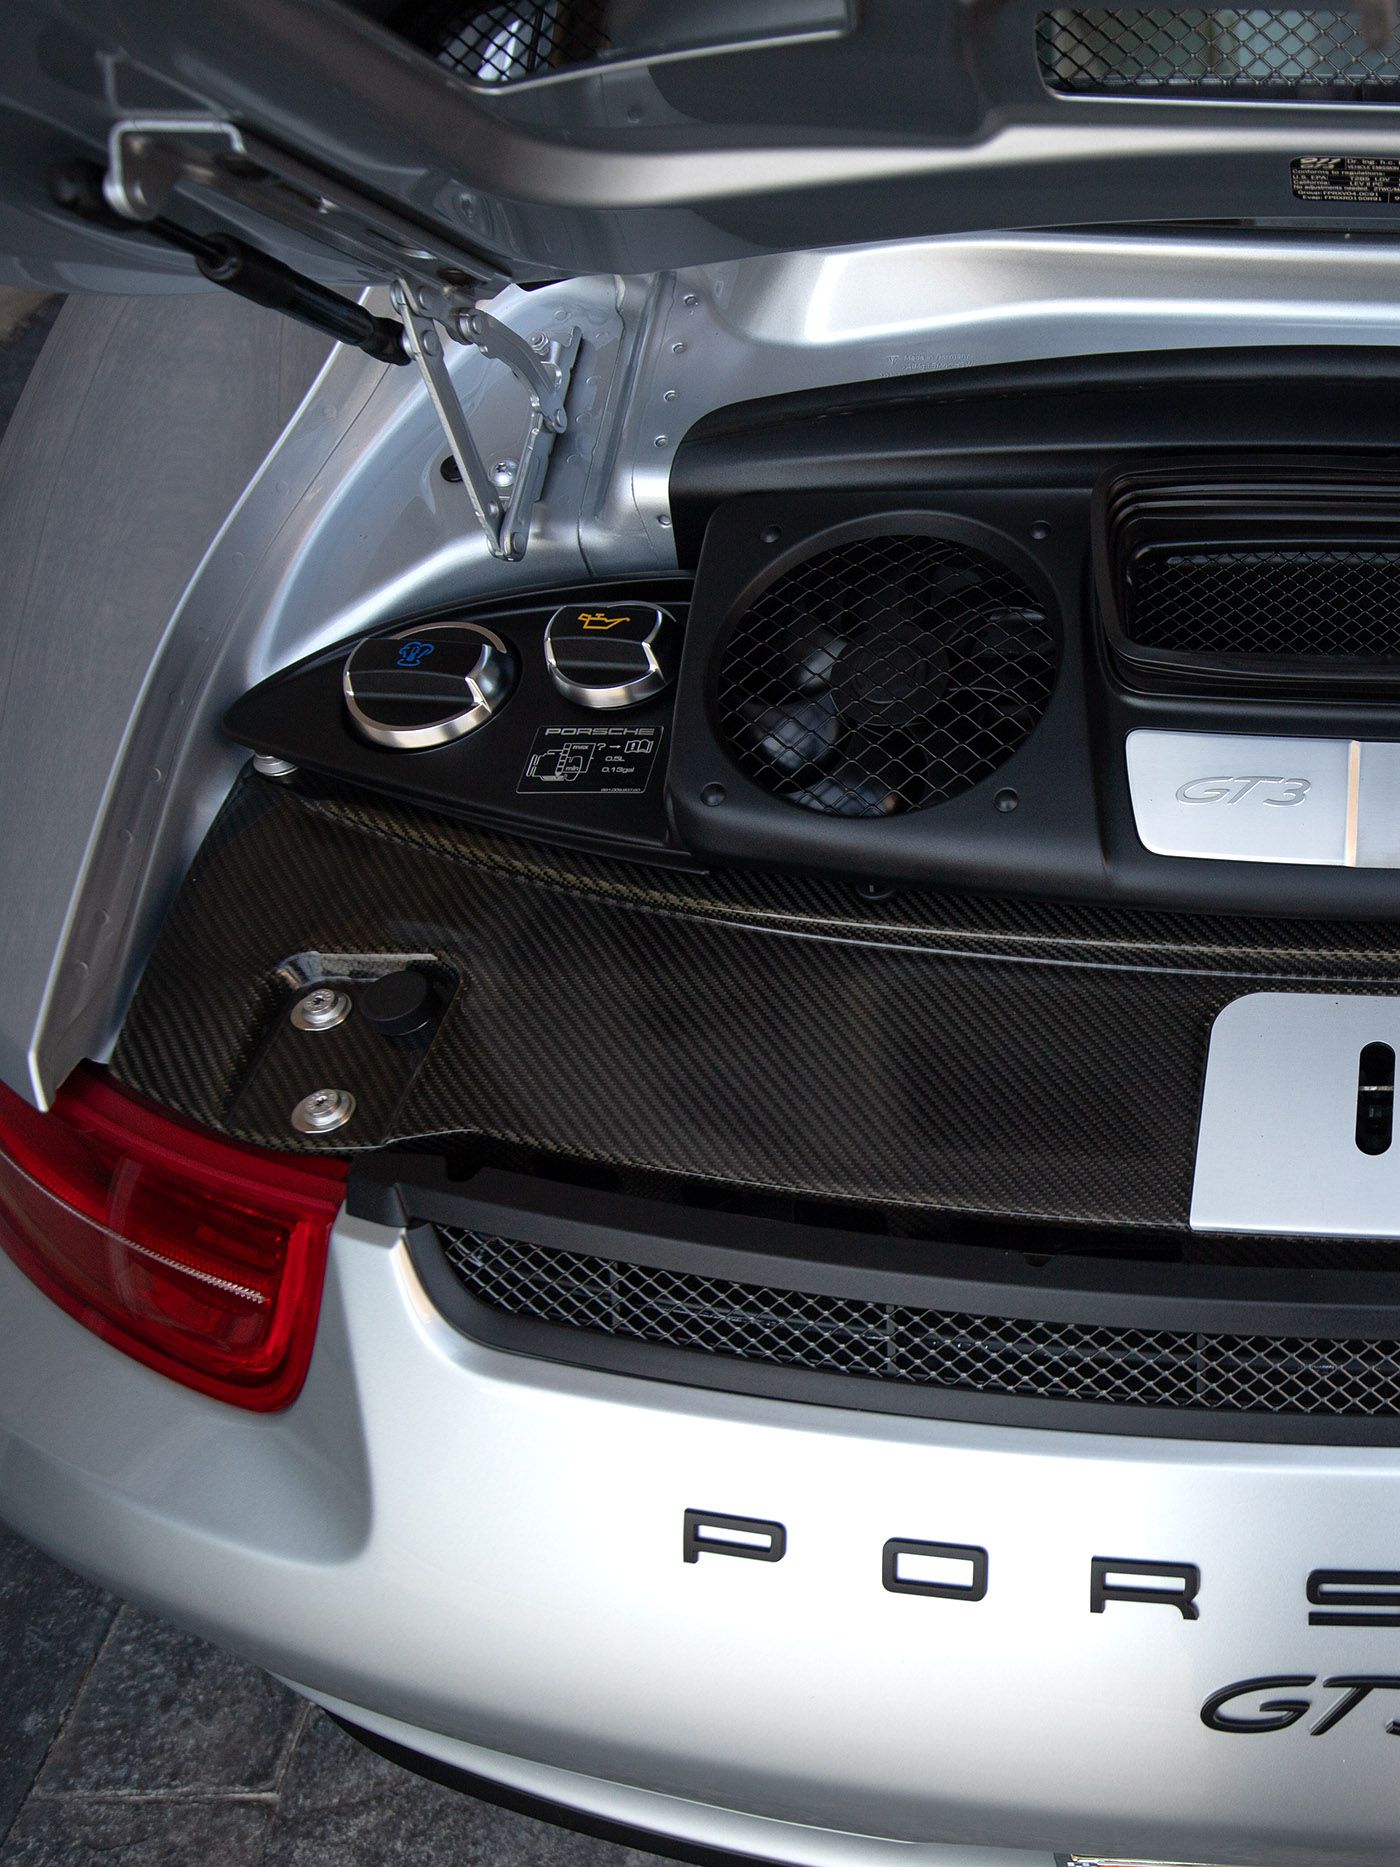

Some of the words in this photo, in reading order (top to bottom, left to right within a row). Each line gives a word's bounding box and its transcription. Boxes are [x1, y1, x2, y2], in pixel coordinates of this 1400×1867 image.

[545, 727, 655, 736] PORSCHE
[601, 766, 635, 774] 0.13gal
[1174, 775, 1312, 808] GT3
